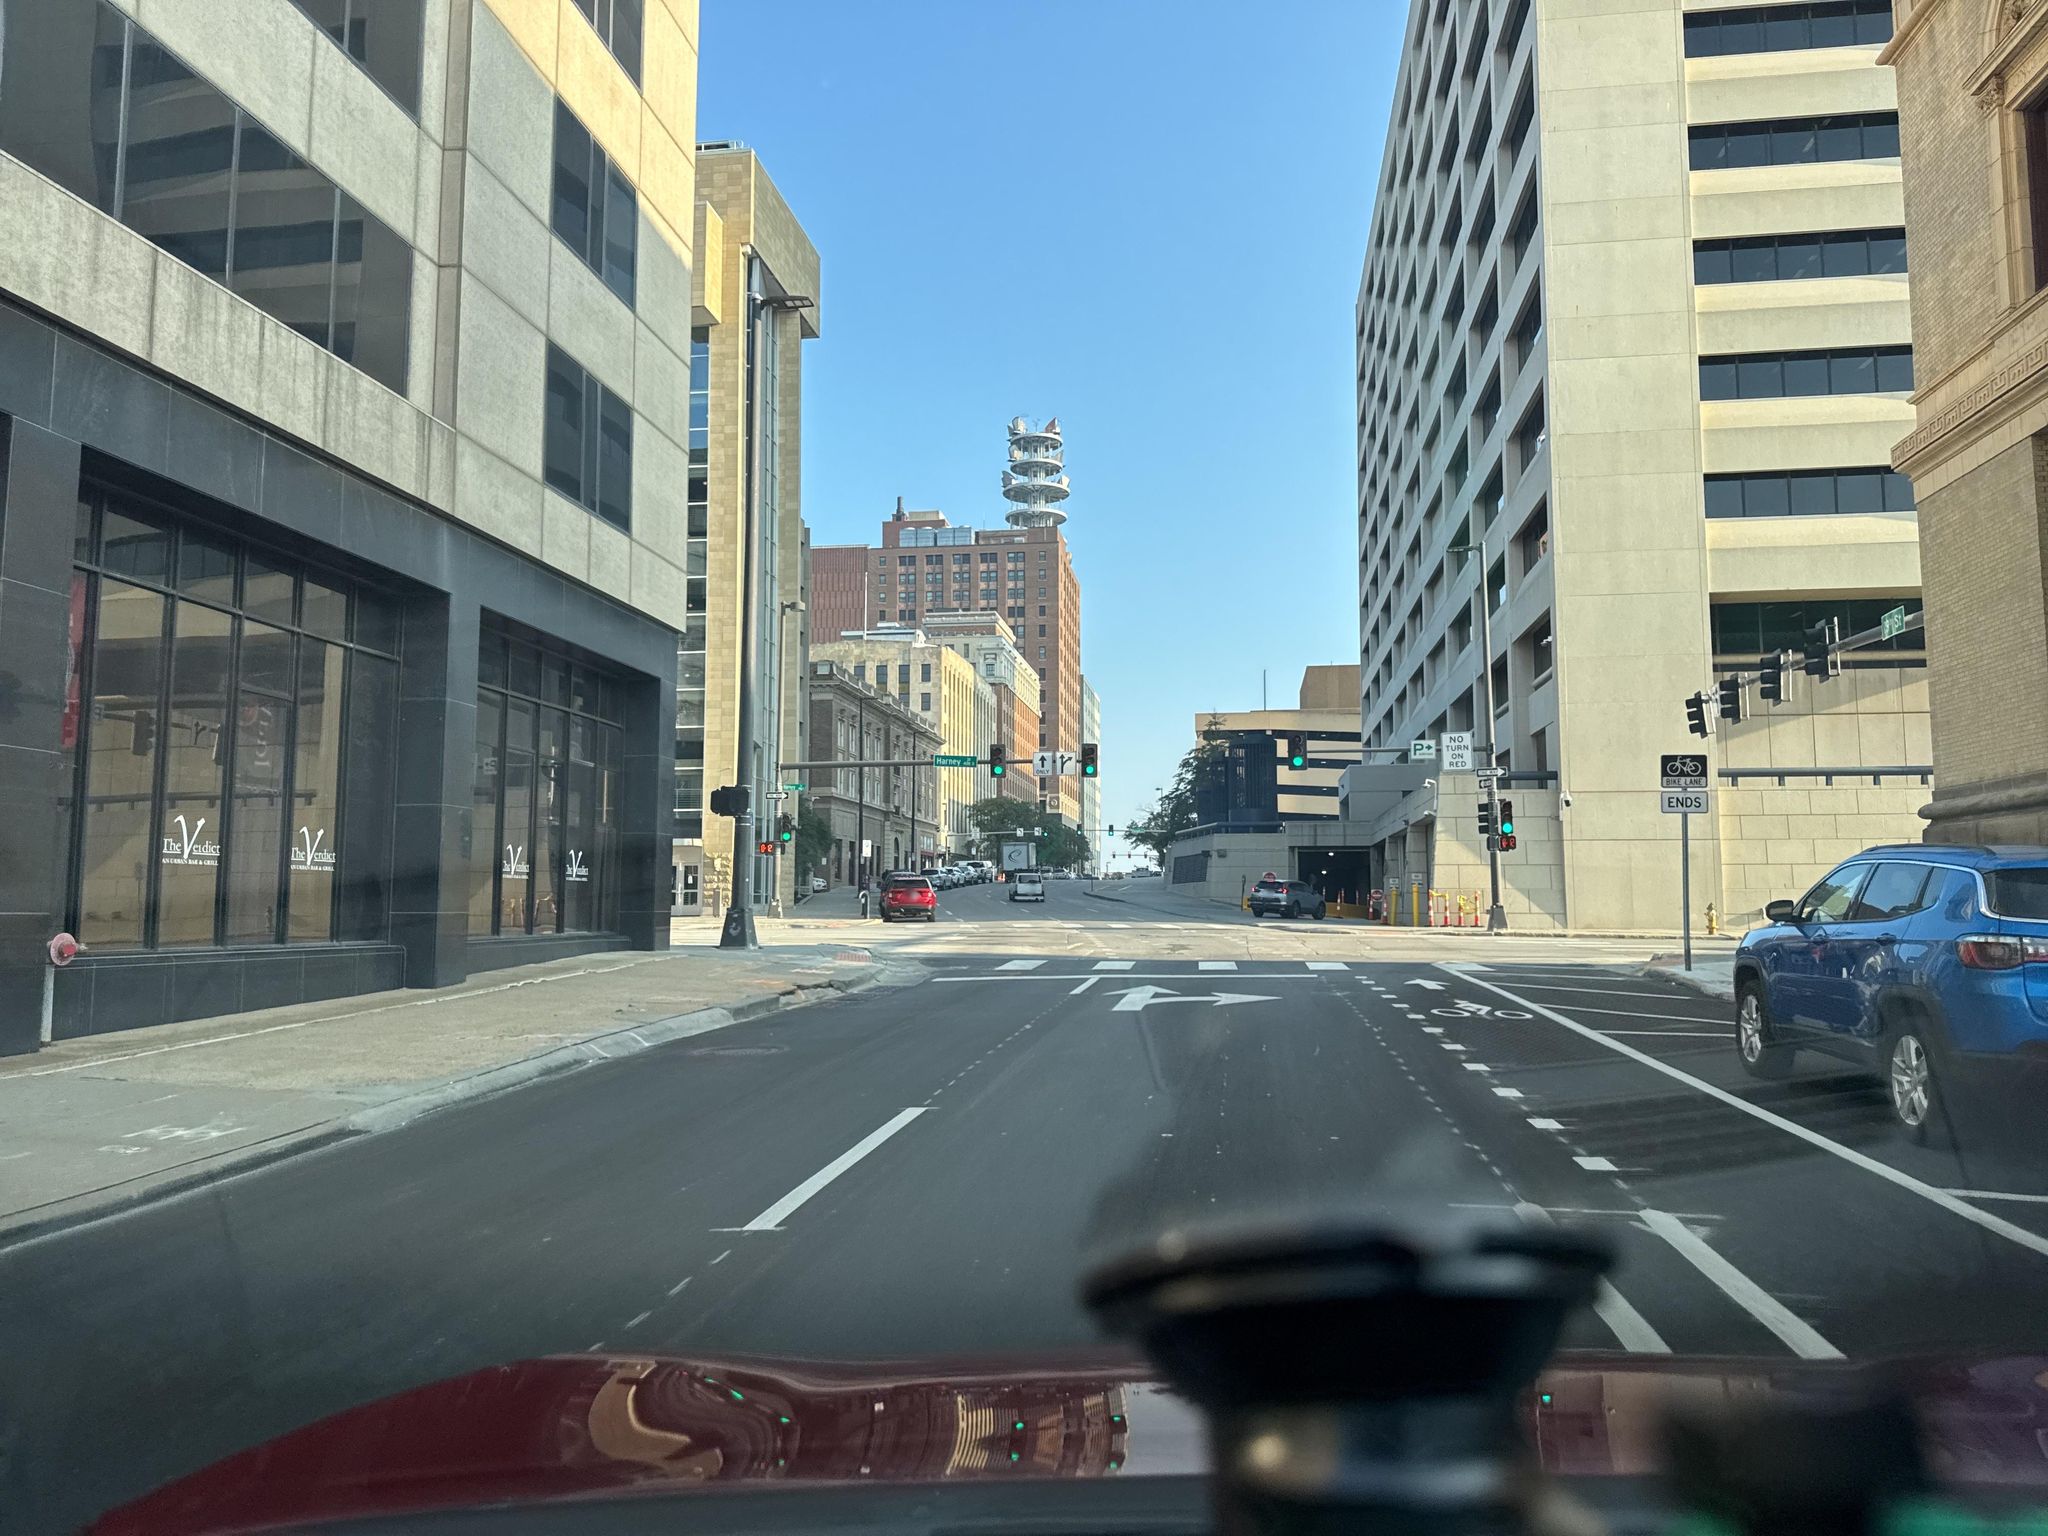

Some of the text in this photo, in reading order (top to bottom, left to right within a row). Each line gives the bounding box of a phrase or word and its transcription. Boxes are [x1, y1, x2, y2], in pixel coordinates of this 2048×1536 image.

[1449, 735, 1464, 743] NO
[1413, 743, 1424, 756] P
[1446, 744, 1469, 752] TURN
[936, 757, 961, 767] Harney
[1449, 760, 1467, 768] RED
[1665, 778, 1702, 786] BIKE LANE
[1667, 796, 1702, 808] ENDS
[162, 815, 220, 859] The Verdict
[291, 826, 336, 866] The Verdict
